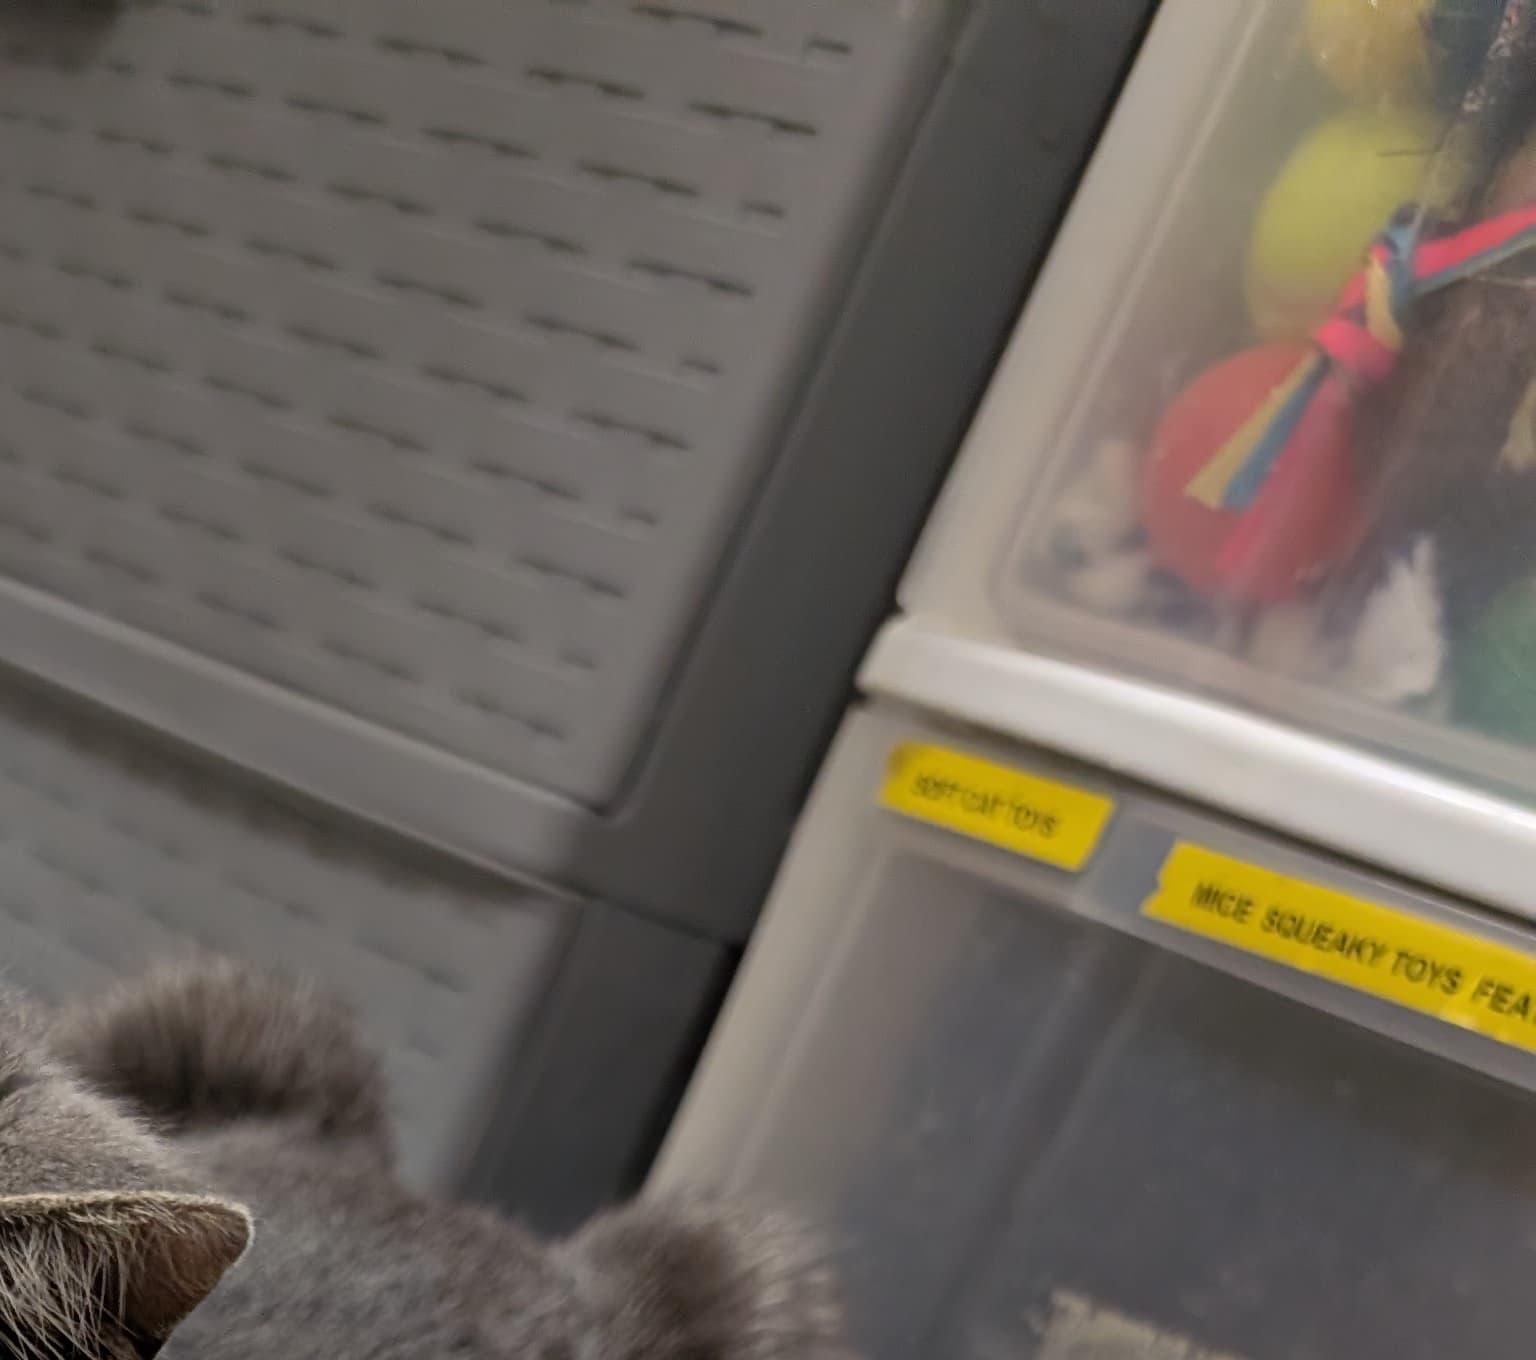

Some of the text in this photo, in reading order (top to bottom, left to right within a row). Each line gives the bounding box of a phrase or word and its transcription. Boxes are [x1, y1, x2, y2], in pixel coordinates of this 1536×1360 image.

[1190, 882, 1536, 1025] MICE SQUEAKY TOYS FEA
